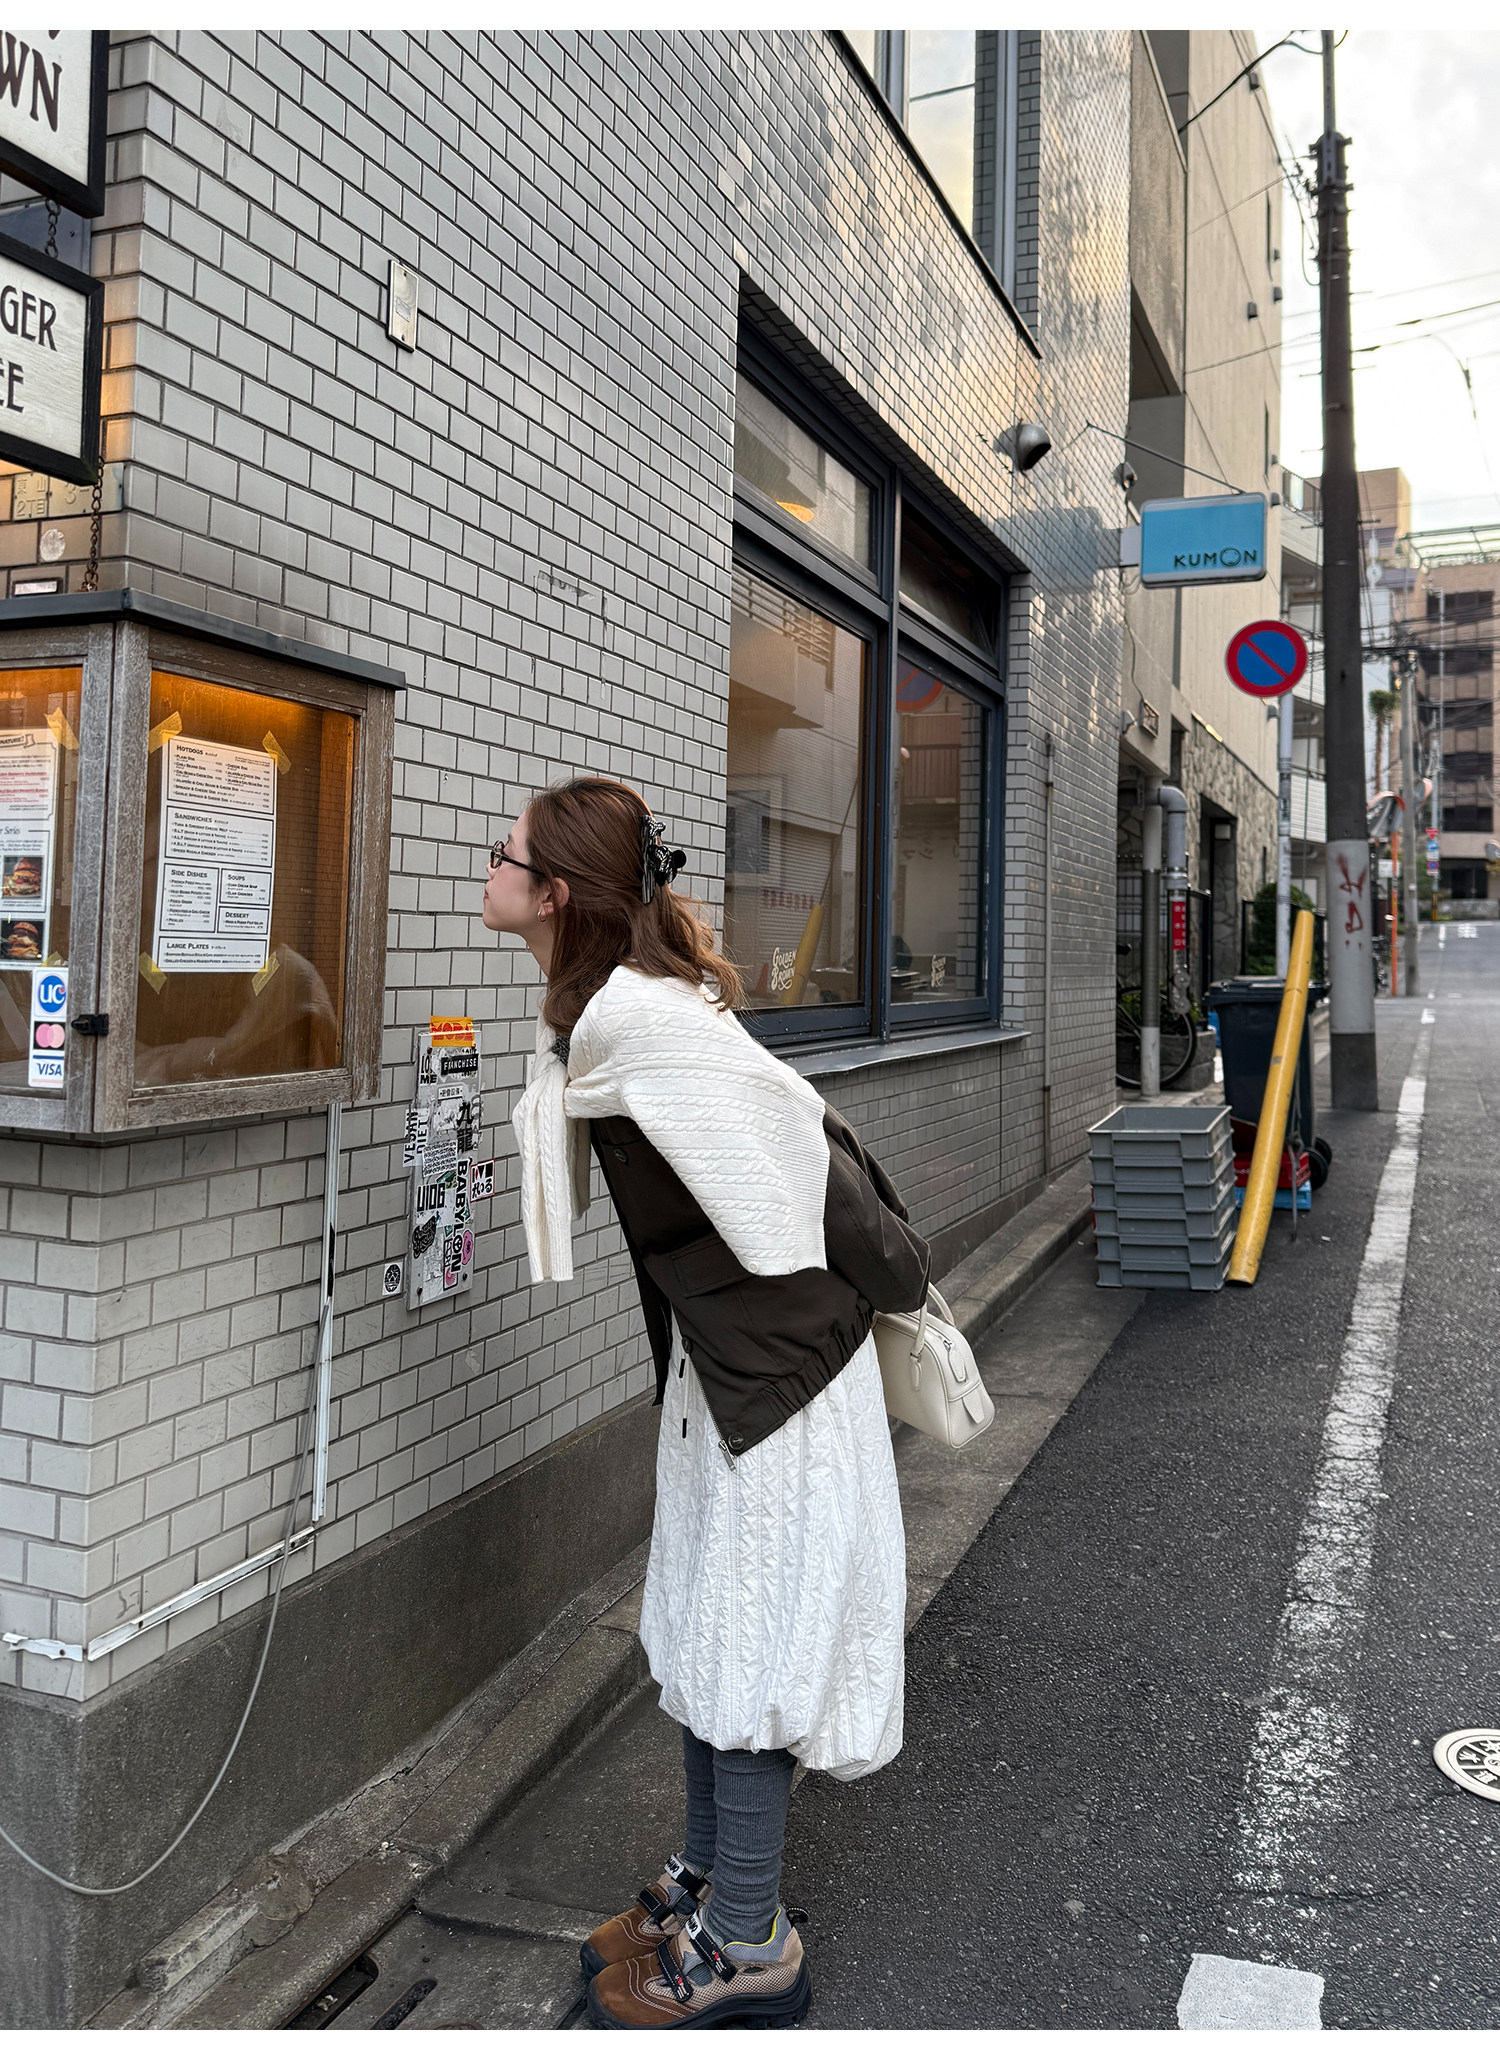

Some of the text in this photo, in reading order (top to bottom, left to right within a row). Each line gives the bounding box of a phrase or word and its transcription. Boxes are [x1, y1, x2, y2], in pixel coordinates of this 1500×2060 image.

[0, 285, 57, 352] GER
[16, 499, 45, 517] 2丁目
[1174, 547, 1257, 569] KUMON
[37, 1063, 62, 1076] VISA
[404, 1111, 418, 1163] VEGAN
[450, 1160, 468, 1272] BABYLON
